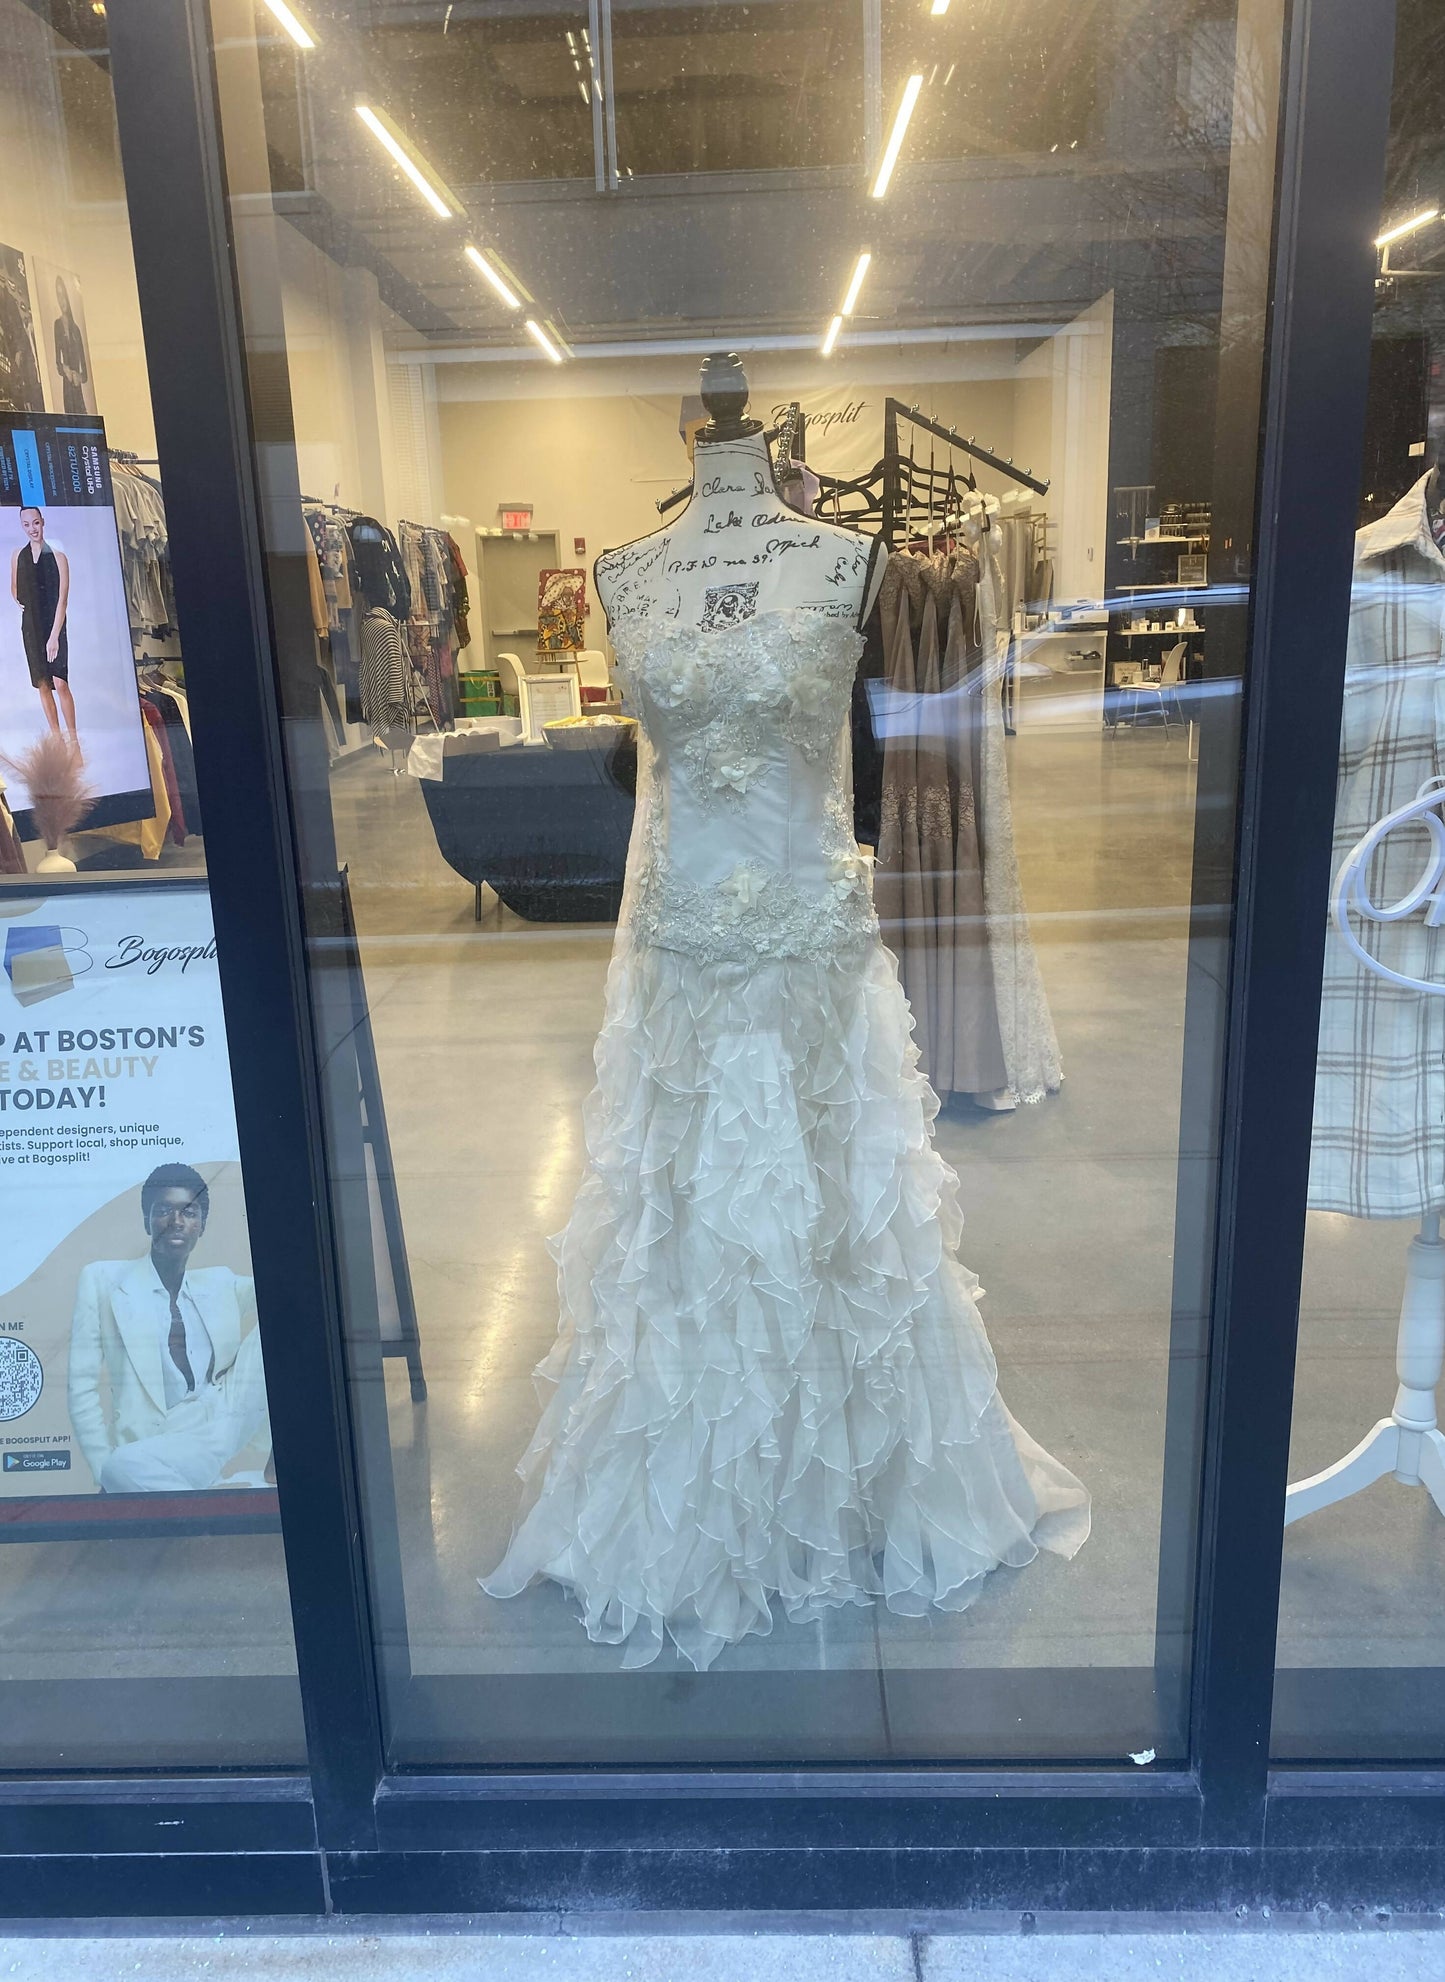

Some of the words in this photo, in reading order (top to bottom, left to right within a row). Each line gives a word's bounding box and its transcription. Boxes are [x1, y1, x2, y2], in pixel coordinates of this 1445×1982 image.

[770, 401, 874, 437] Bgosplit
[67, 445, 82, 493] 82TU7000
[82, 445, 91, 477] Crystal
[90, 446, 103, 489] SAMSUNG
[86, 477, 95, 495] UHD
[702, 476, 746, 498] Clara
[104, 935, 219, 975] Bogospli
[13, 1030, 50, 1054] AT
[58, 1025, 205, 1052] BOSTON'S
[18, 1060, 40, 1082] &
[47, 1055, 160, 1081] BEAUTY
[0, 1085, 107, 1111] TODAY!
[56, 1124, 117, 1138] designers,
[119, 1122, 160, 1135] unique
[27, 1139, 74, 1153] Support
[76, 1138, 107, 1149] local,
[109, 1137, 139, 1150] shop
[141, 1135, 185, 1147] unique,
[17, 1154, 30, 1164] at
[32, 1152, 91, 1166] Bogosplit!
[8, 1321, 24, 1331] ME
[5, 1436, 51, 1445] BOGOSPLIT
[52, 1435, 71, 1443] APP!
[22, 1459, 51, 1469] Google
[51, 1458, 67, 1468] Play
